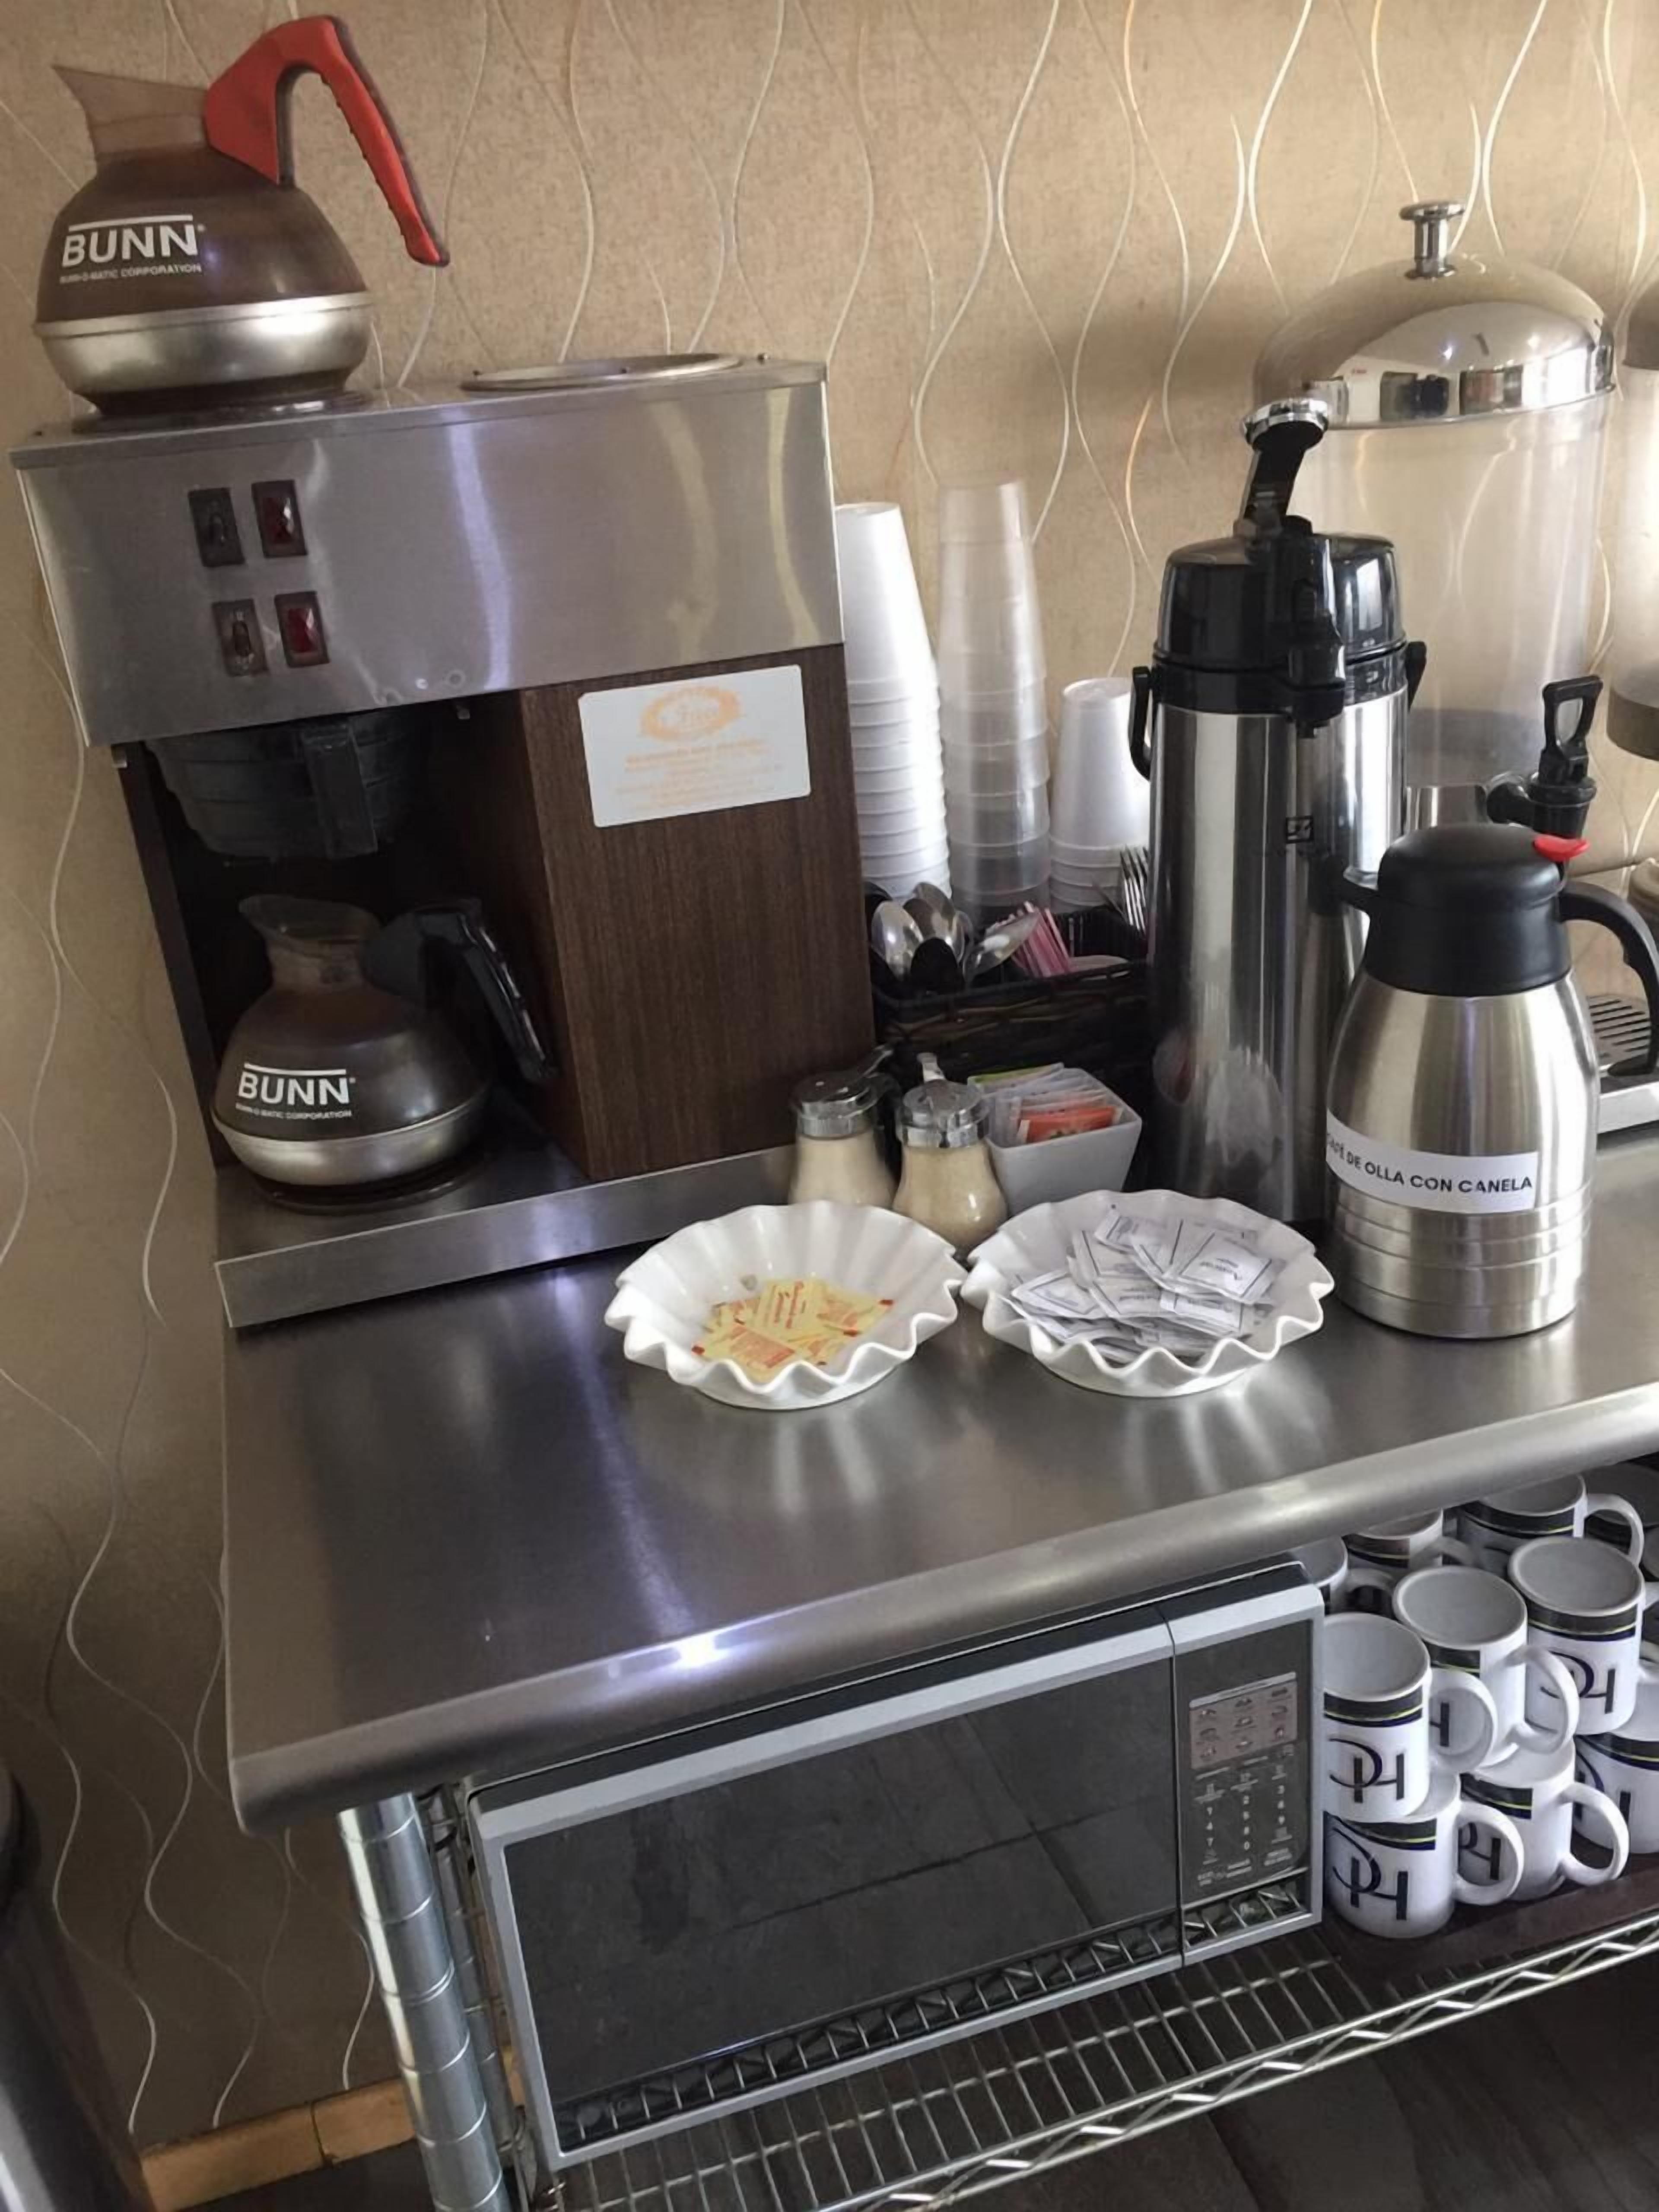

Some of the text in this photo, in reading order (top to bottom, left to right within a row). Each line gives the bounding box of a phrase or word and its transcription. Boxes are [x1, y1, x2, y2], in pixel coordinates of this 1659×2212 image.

[62, 224, 199, 268] BUNN
[121, 263, 203, 277] CORPORATION
[238, 1071, 350, 1106] BUNN
[1347, 1150, 1361, 1170] DE
[1365, 1161, 1404, 1185] OLLA
[1410, 1175, 1452, 1192] CON
[1458, 1176, 1532, 1192] CANELA
